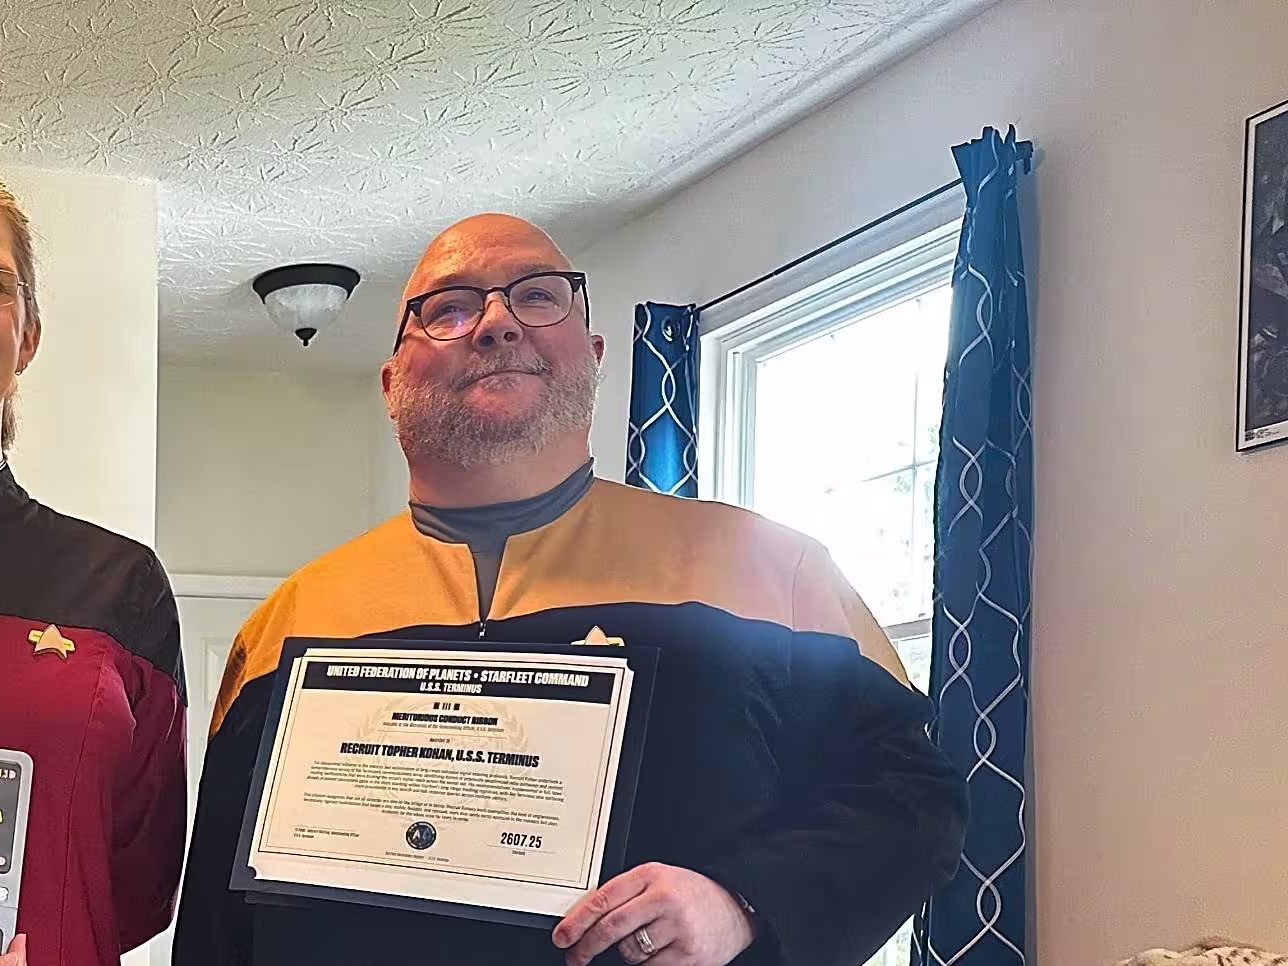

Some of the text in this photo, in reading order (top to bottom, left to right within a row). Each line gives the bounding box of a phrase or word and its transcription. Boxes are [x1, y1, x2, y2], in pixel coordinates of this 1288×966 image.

[327, 665, 589, 687] UNITED FEDERATION OF PLANETS STARFLEET COMMAND
[420, 681, 482, 693] U.S.S. TERMINUS
[439, 714, 472, 725] CONDUCT
[340, 742, 540, 768] RECRUIT TOPHER KOHAN, U.S.S. TERMINUS
[500, 832, 542, 848] 2607.25
